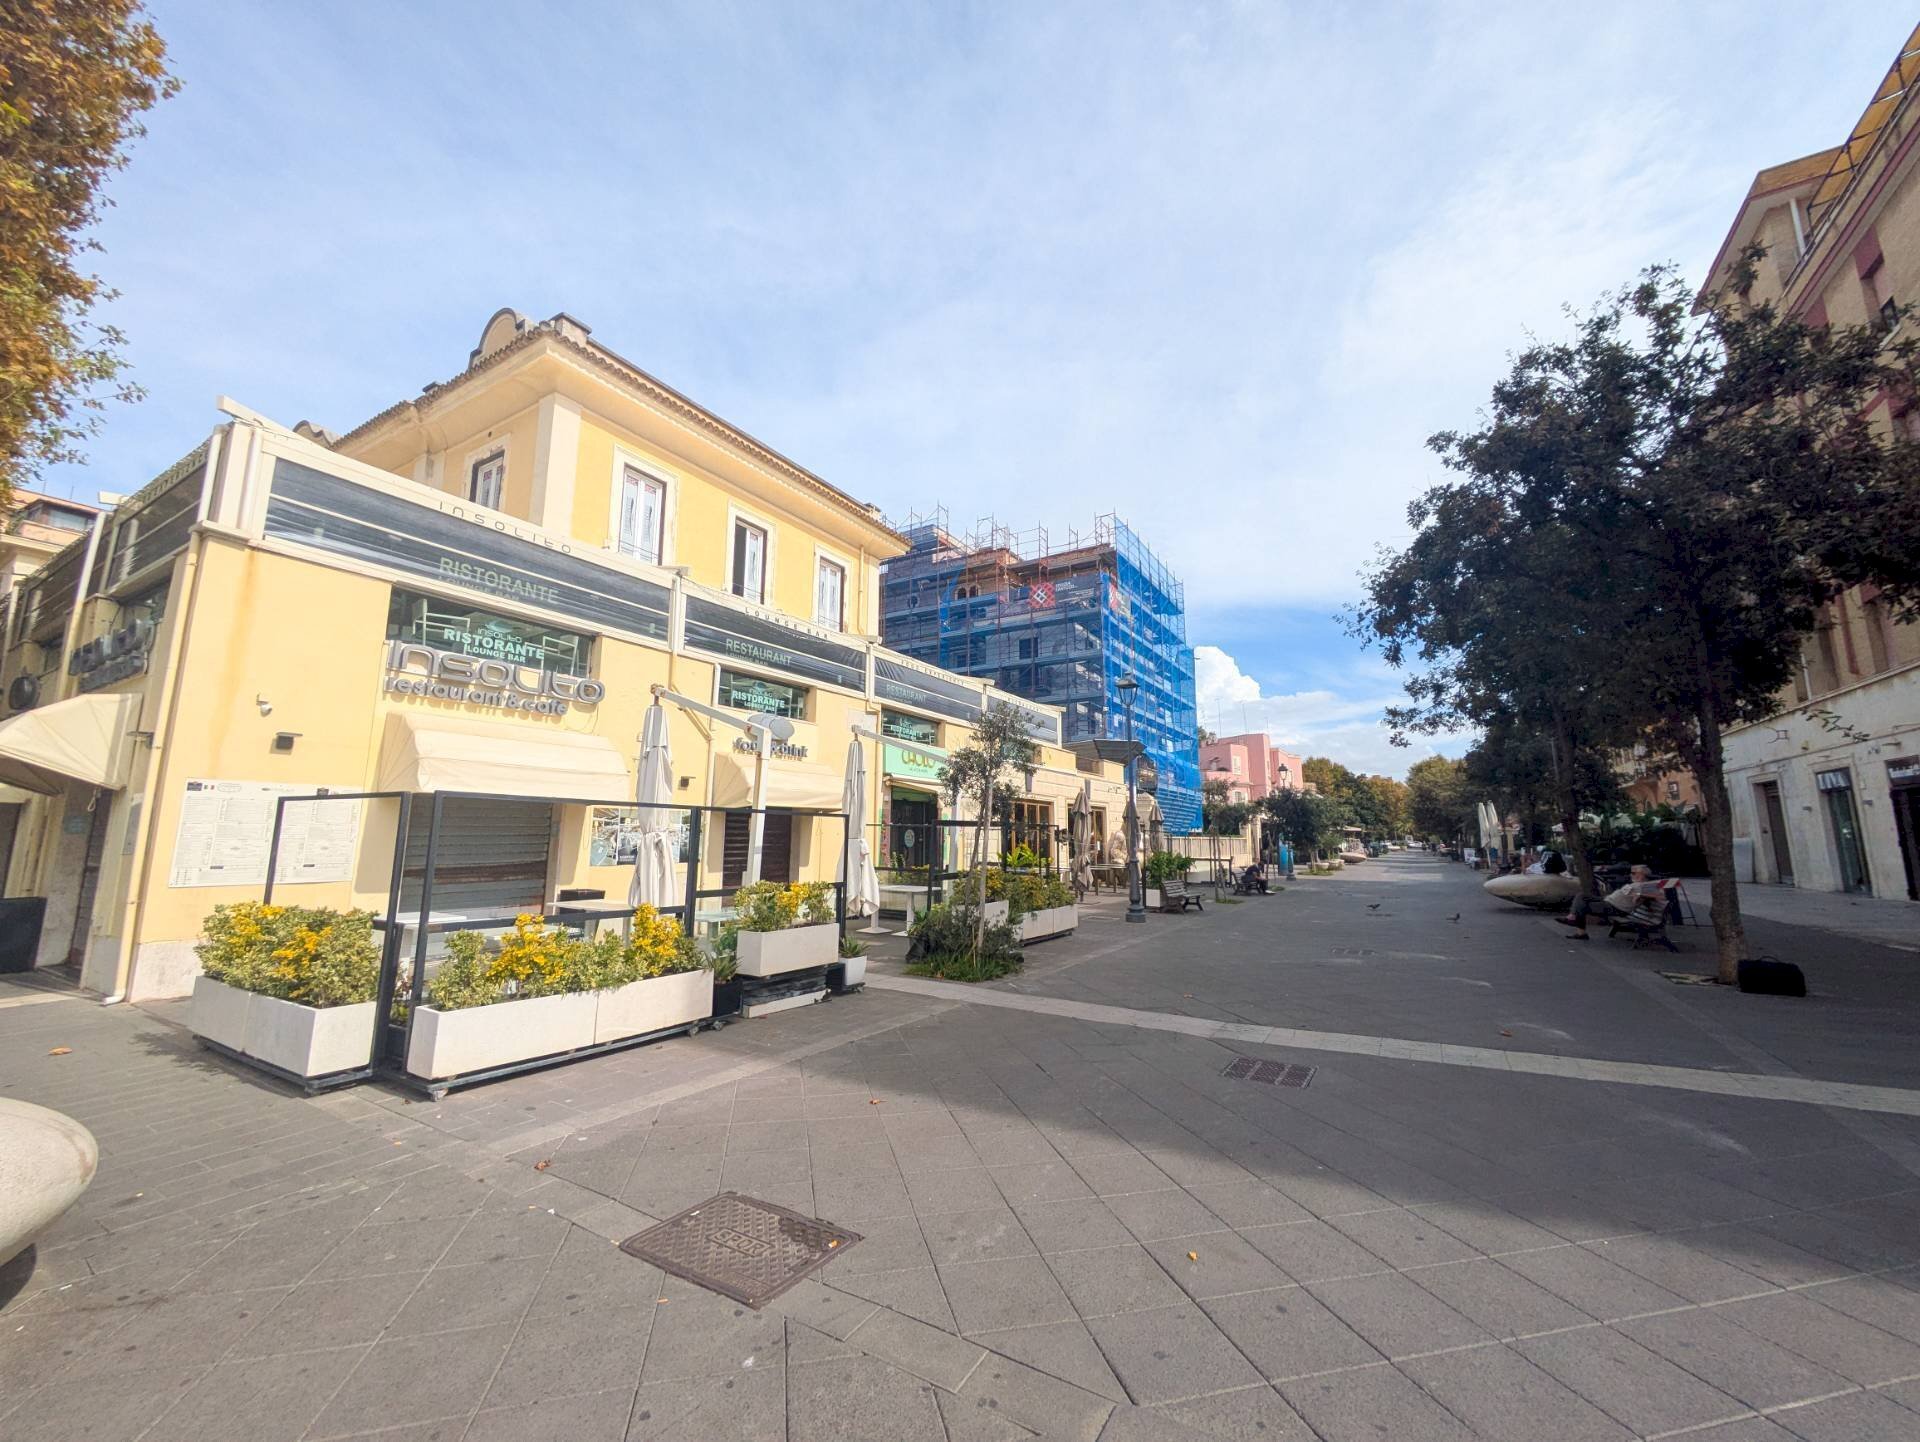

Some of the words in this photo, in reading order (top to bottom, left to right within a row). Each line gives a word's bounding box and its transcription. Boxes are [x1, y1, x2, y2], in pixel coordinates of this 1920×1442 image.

[440, 557, 560, 602] RISTORANTE
[745, 606, 798, 630] LOUNGE
[443, 627, 546, 660] RISTORANTE
[467, 644, 506, 659] LOUNGE
[507, 653, 526, 664] BAR
[726, 639, 792, 666] RESTAURANT
[384, 676, 504, 708] restaurant
[732, 690, 785, 709] RISTORANTE
[714, 1229, 766, 1255] SPQR
